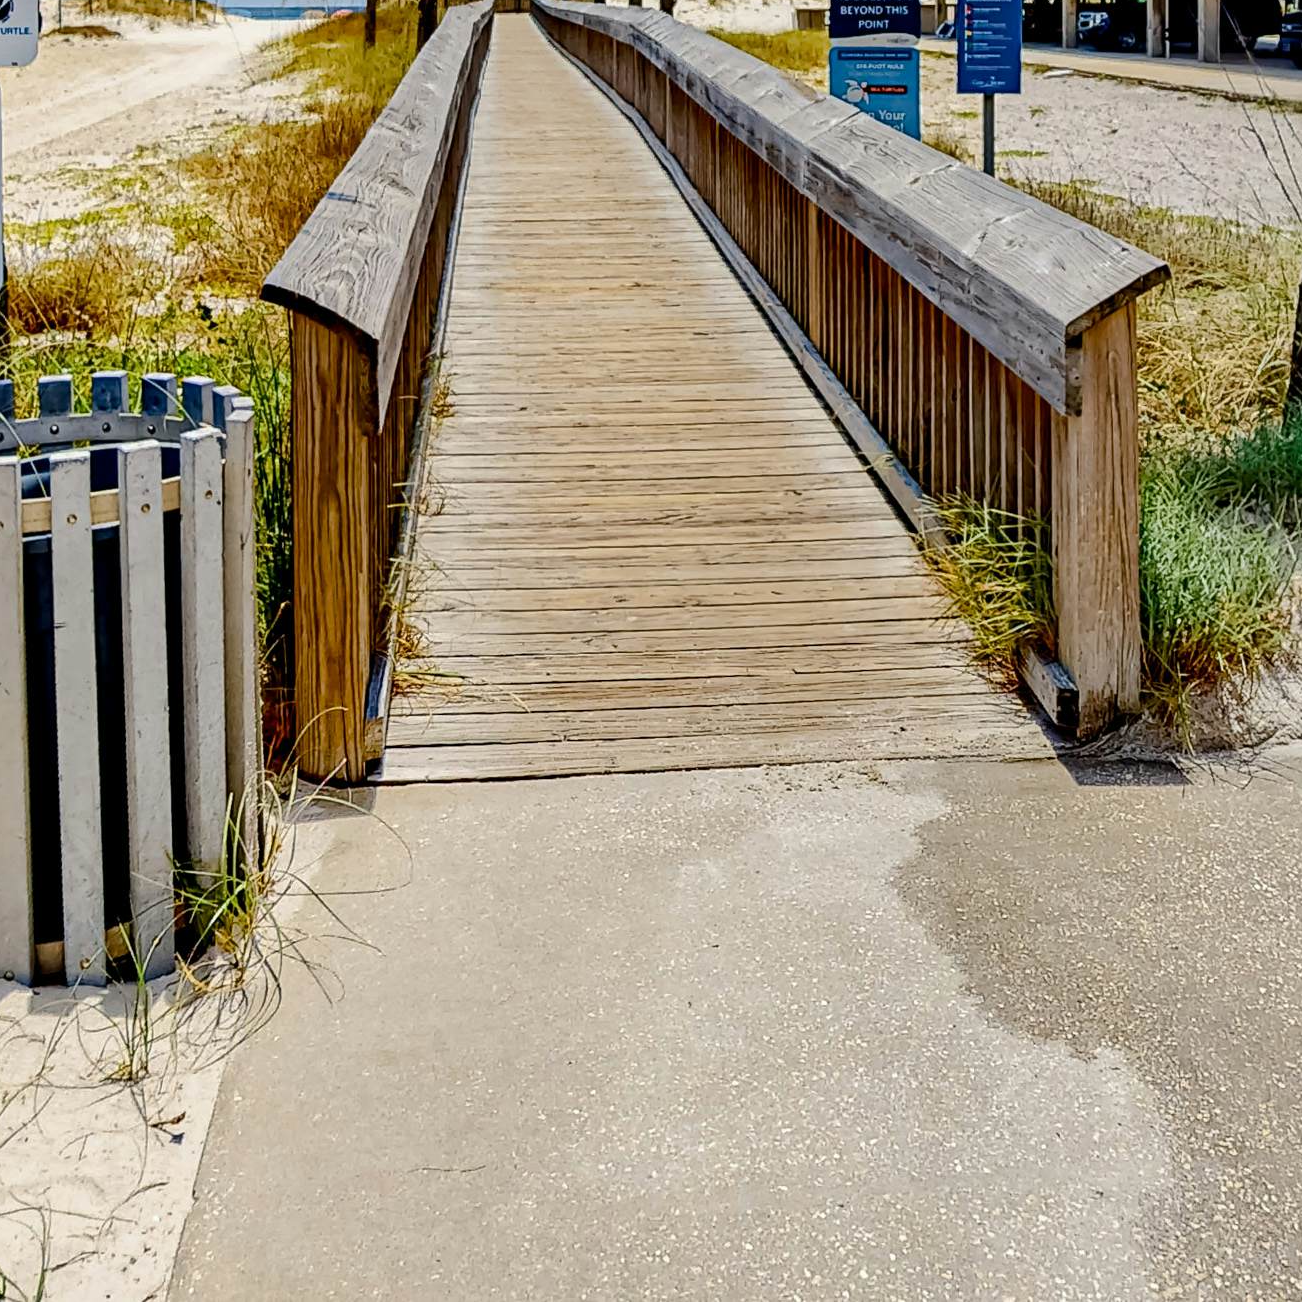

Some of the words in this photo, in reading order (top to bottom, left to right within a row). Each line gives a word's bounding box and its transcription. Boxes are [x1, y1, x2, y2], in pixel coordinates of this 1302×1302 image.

[840, 6, 883, 15] BEYOND
[885, 6, 909, 15] THIS
[858, 20, 889, 29] POINT
[878, 110, 906, 120] Your
